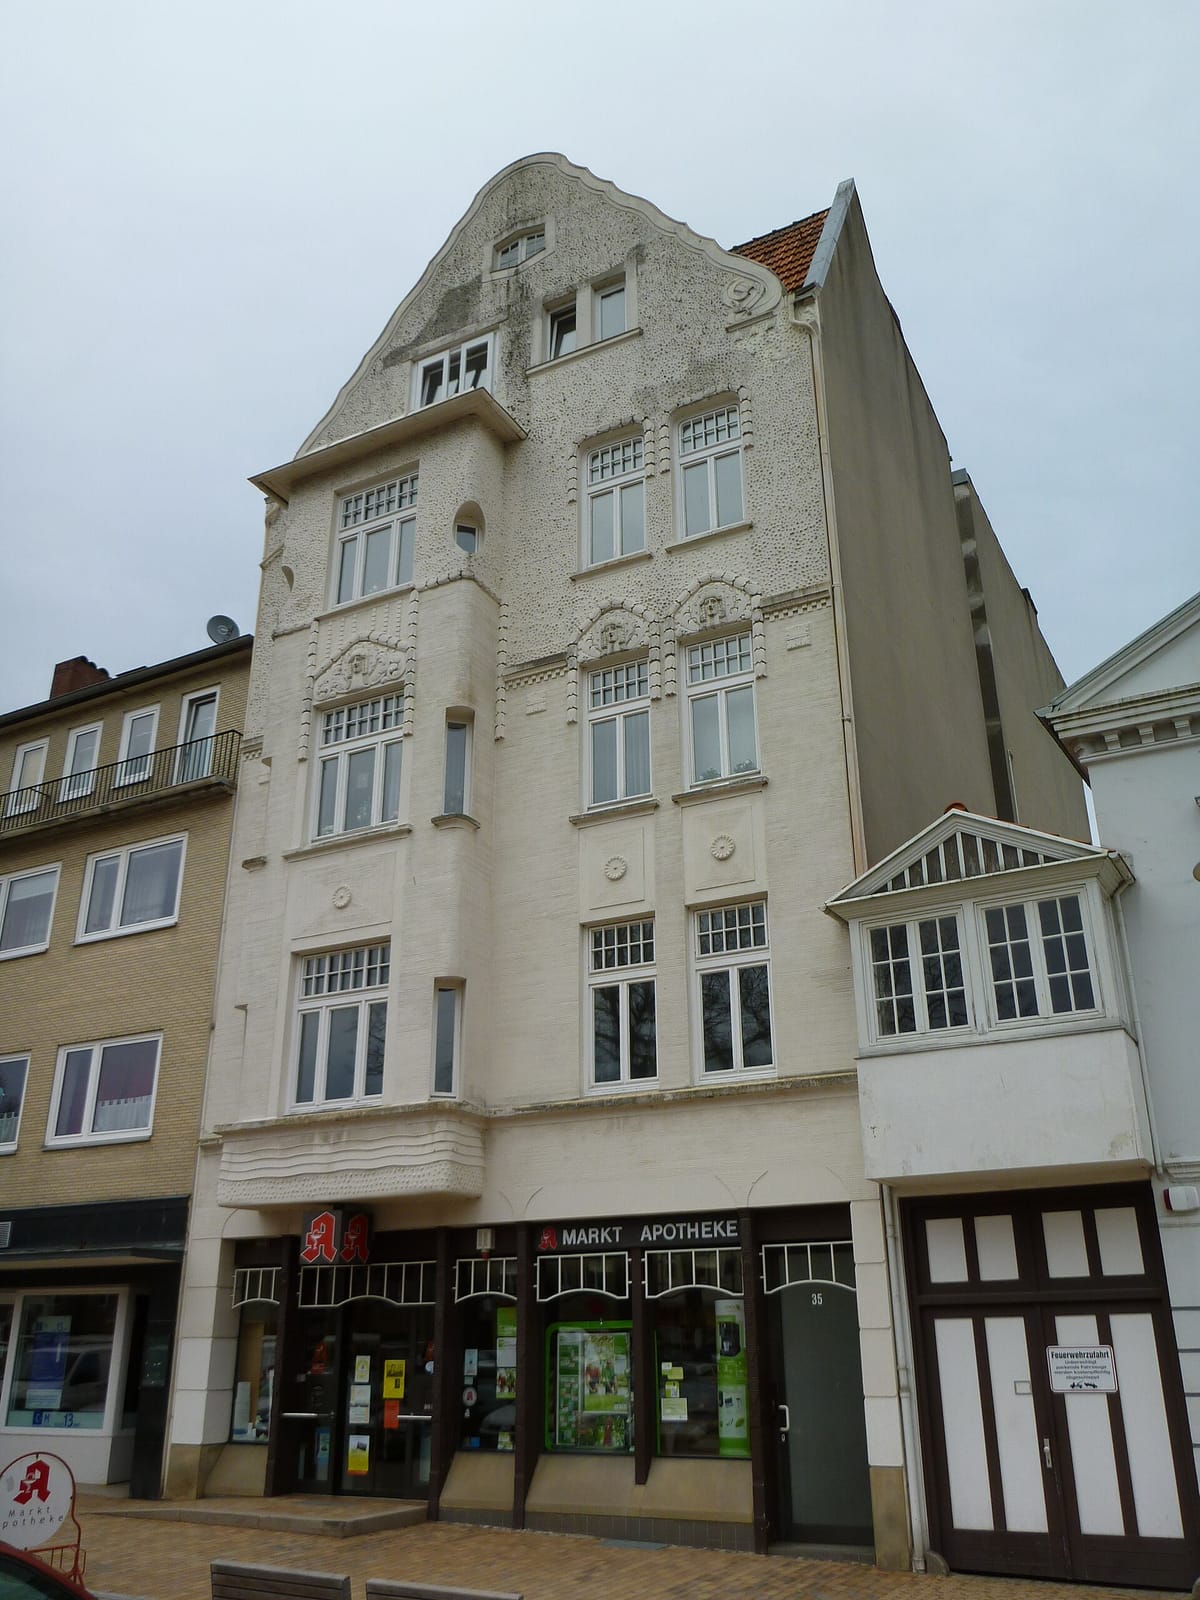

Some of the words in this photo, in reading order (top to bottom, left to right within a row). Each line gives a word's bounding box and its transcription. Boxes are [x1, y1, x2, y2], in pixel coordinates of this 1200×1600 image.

[562, 1226, 623, 1245] MARKT
[640, 1220, 738, 1242] APOTHEKE
[811, 1293, 823, 1305] 35
[1051, 1351, 1109, 1359] Feuerwehrzufahrt
[9, 1506, 50, 1518] Markt
[2, 1515, 63, 1529] potheke
